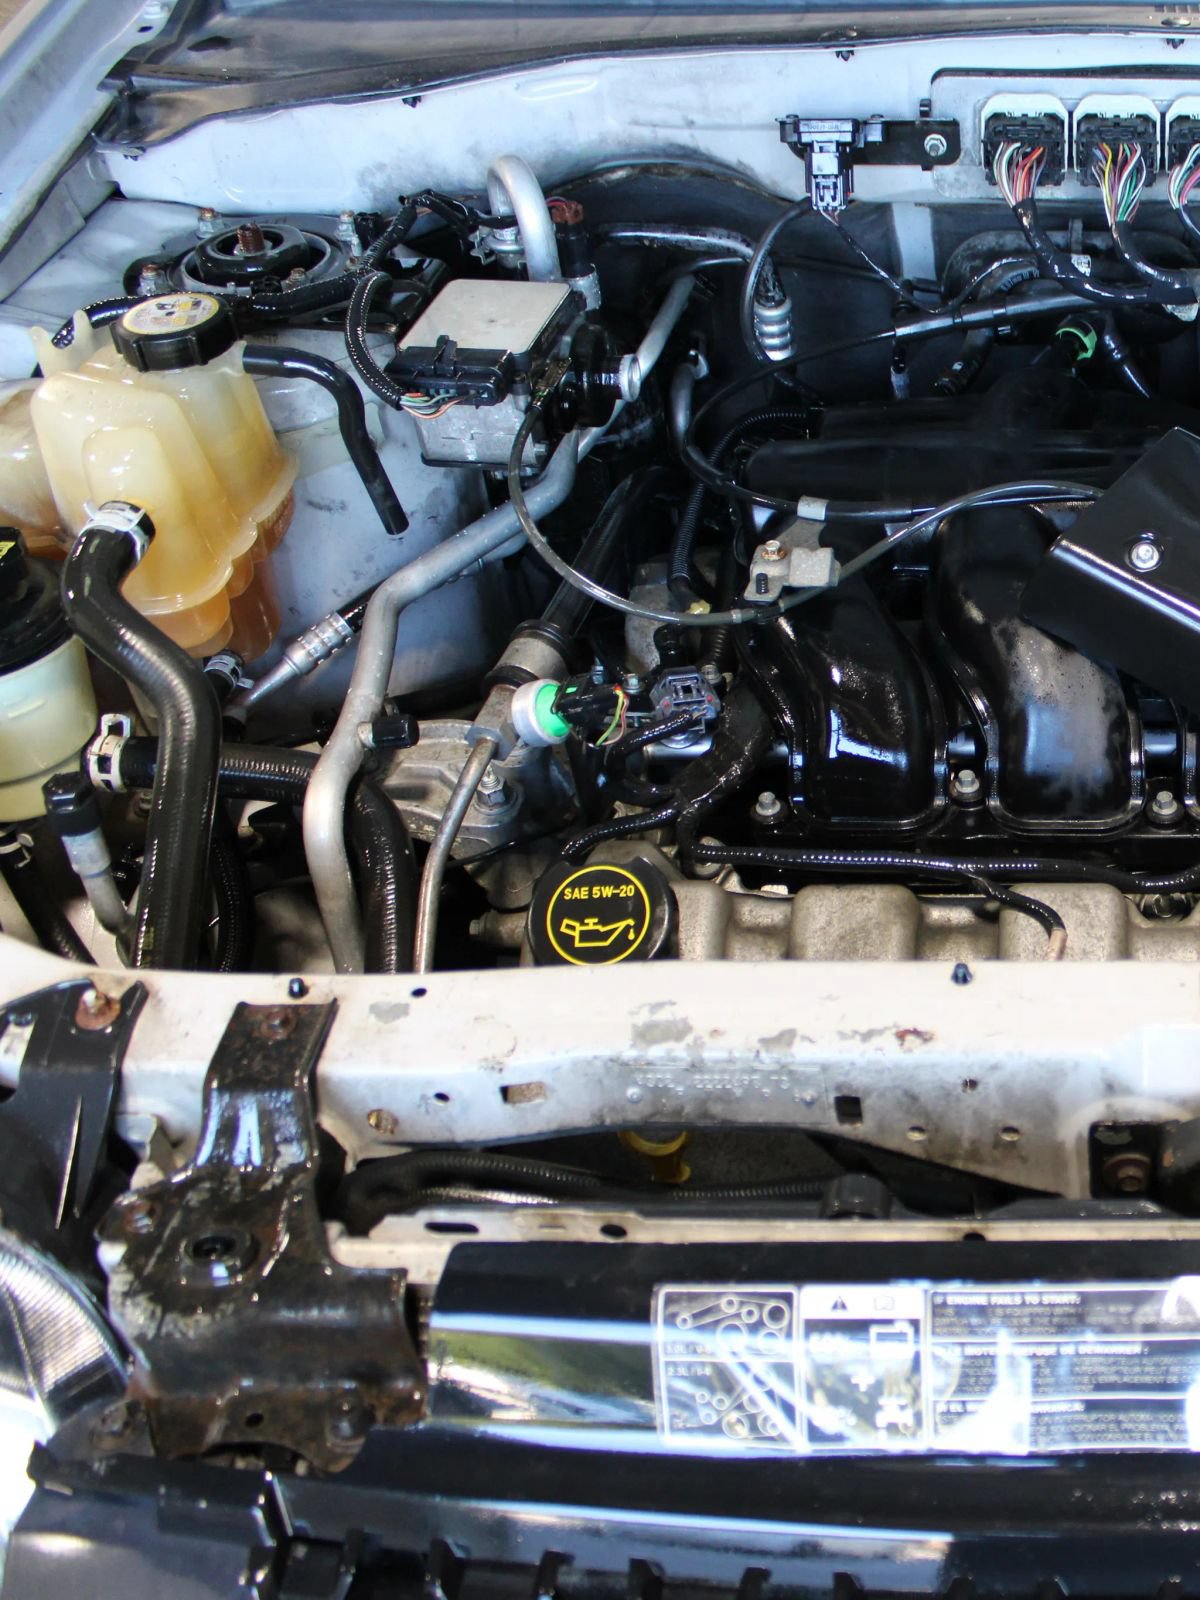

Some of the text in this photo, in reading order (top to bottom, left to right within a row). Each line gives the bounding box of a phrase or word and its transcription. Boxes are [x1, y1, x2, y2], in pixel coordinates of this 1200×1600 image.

[563, 884, 635, 900] SAE 5W-20
[1024, 1294, 1040, 1304] TO
